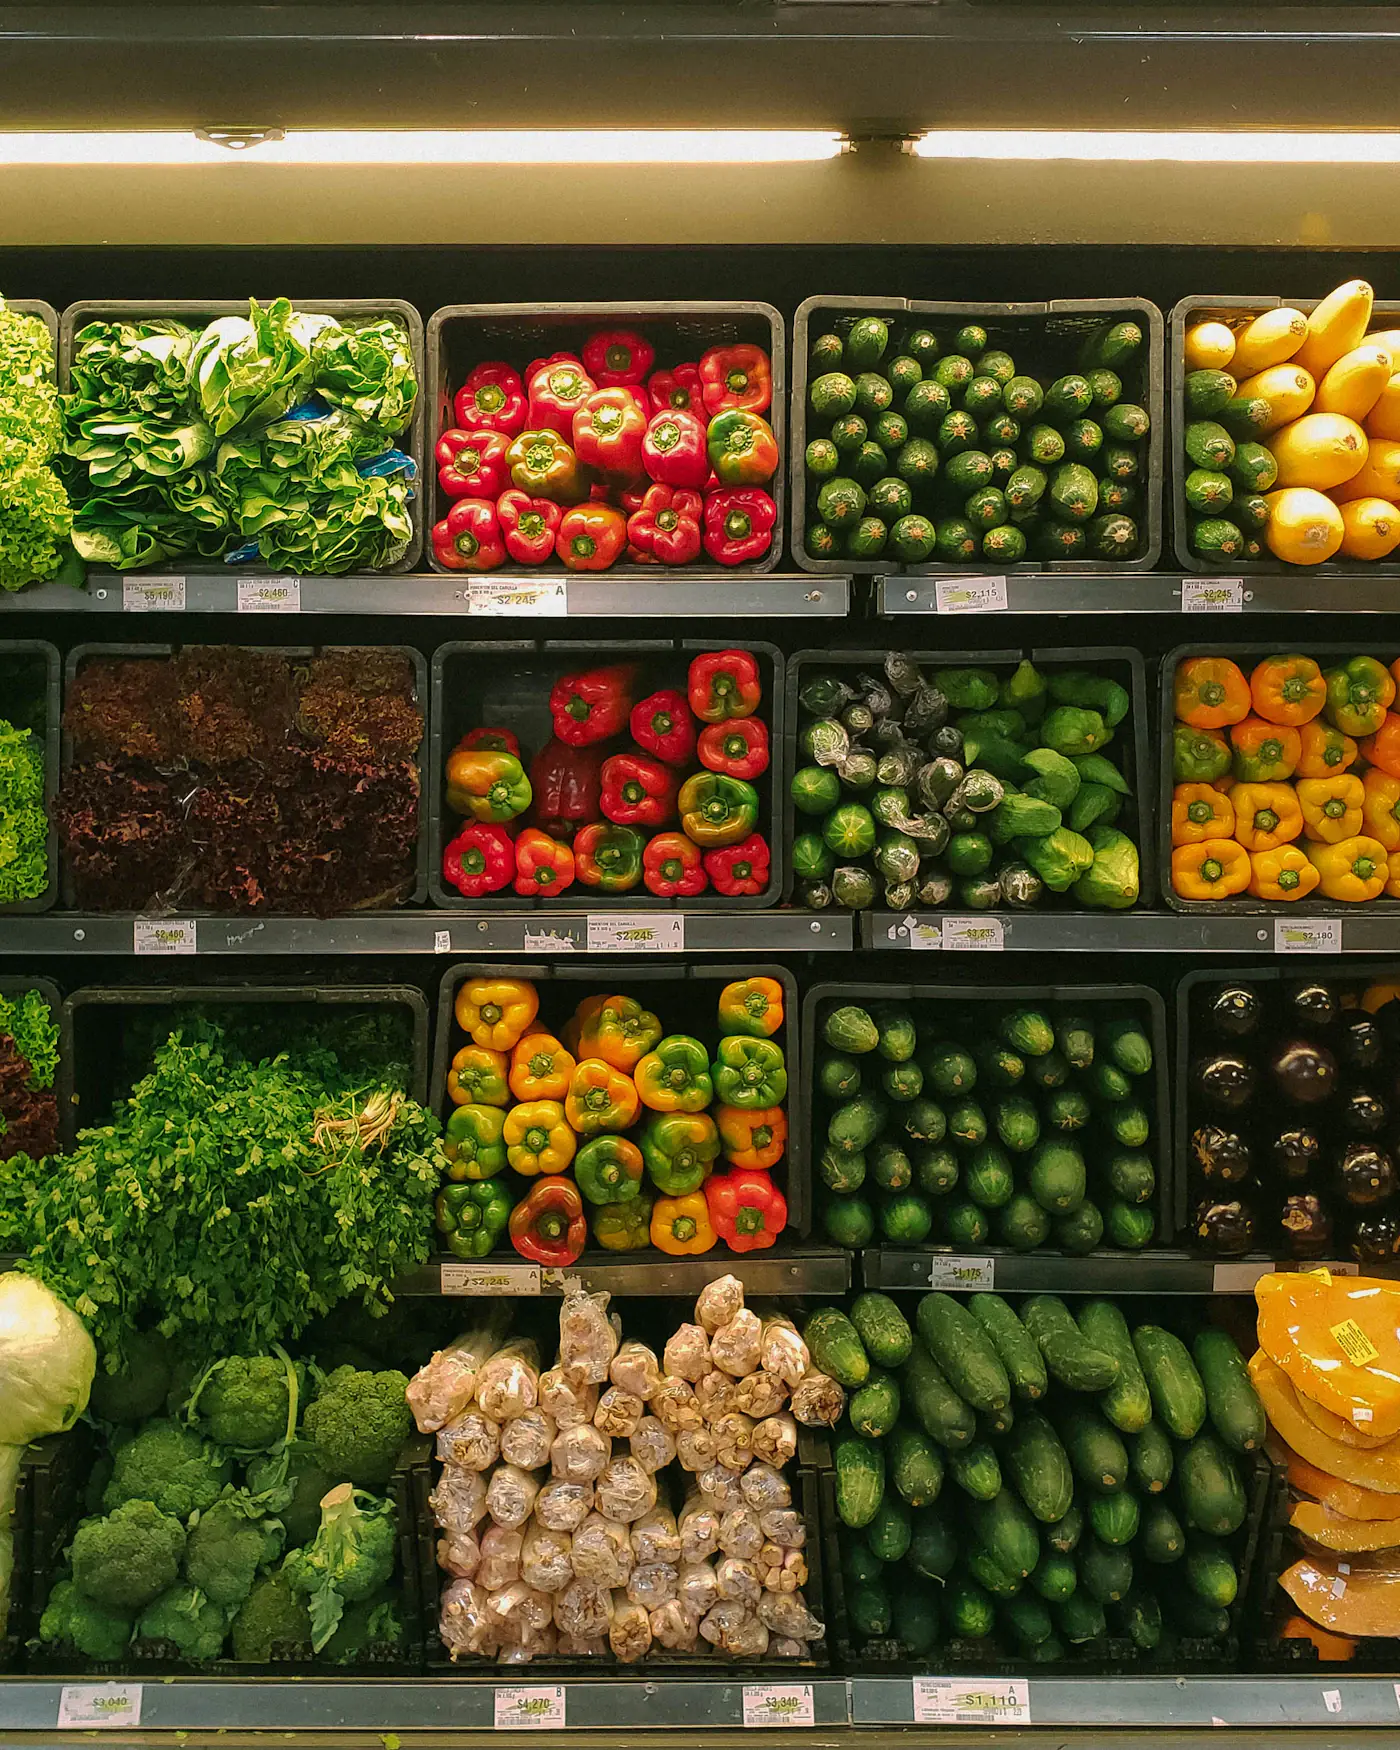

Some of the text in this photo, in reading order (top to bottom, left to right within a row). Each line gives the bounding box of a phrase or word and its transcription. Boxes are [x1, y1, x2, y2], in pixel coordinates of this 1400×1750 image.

[178, 583, 184, 591] C
[293, 580, 298, 588] C
[1237, 581, 1243, 589] A
[555, 586, 564, 595] A
[965, 588, 997, 599] $2,115
[1204, 589, 1232, 600] $2,245
[144, 591, 173, 601] $5,190
[189, 920, 195, 930] C
[672, 921, 680, 931] A
[155, 929, 184, 940] $2,460
[616, 931, 654, 942] $2,245
[967, 928, 996, 939] $3,235
[1302, 932, 1333, 940] $2,180
[986, 1260, 992, 1269] A
[529, 1271, 538, 1279] A
[953, 1267, 982, 1278] $1,175
[471, 1277, 510, 1287] $2,245
[556, 1687, 561, 1697] B
[803, 1686, 810, 1697] A
[1009, 1685, 1015, 1694] A
[92, 1697, 127, 1707] $3,040
[517, 1698, 550, 1710] $4,270
[765, 1696, 799, 1708] $3,340
[965, 1694, 1017, 1707] $1,110
